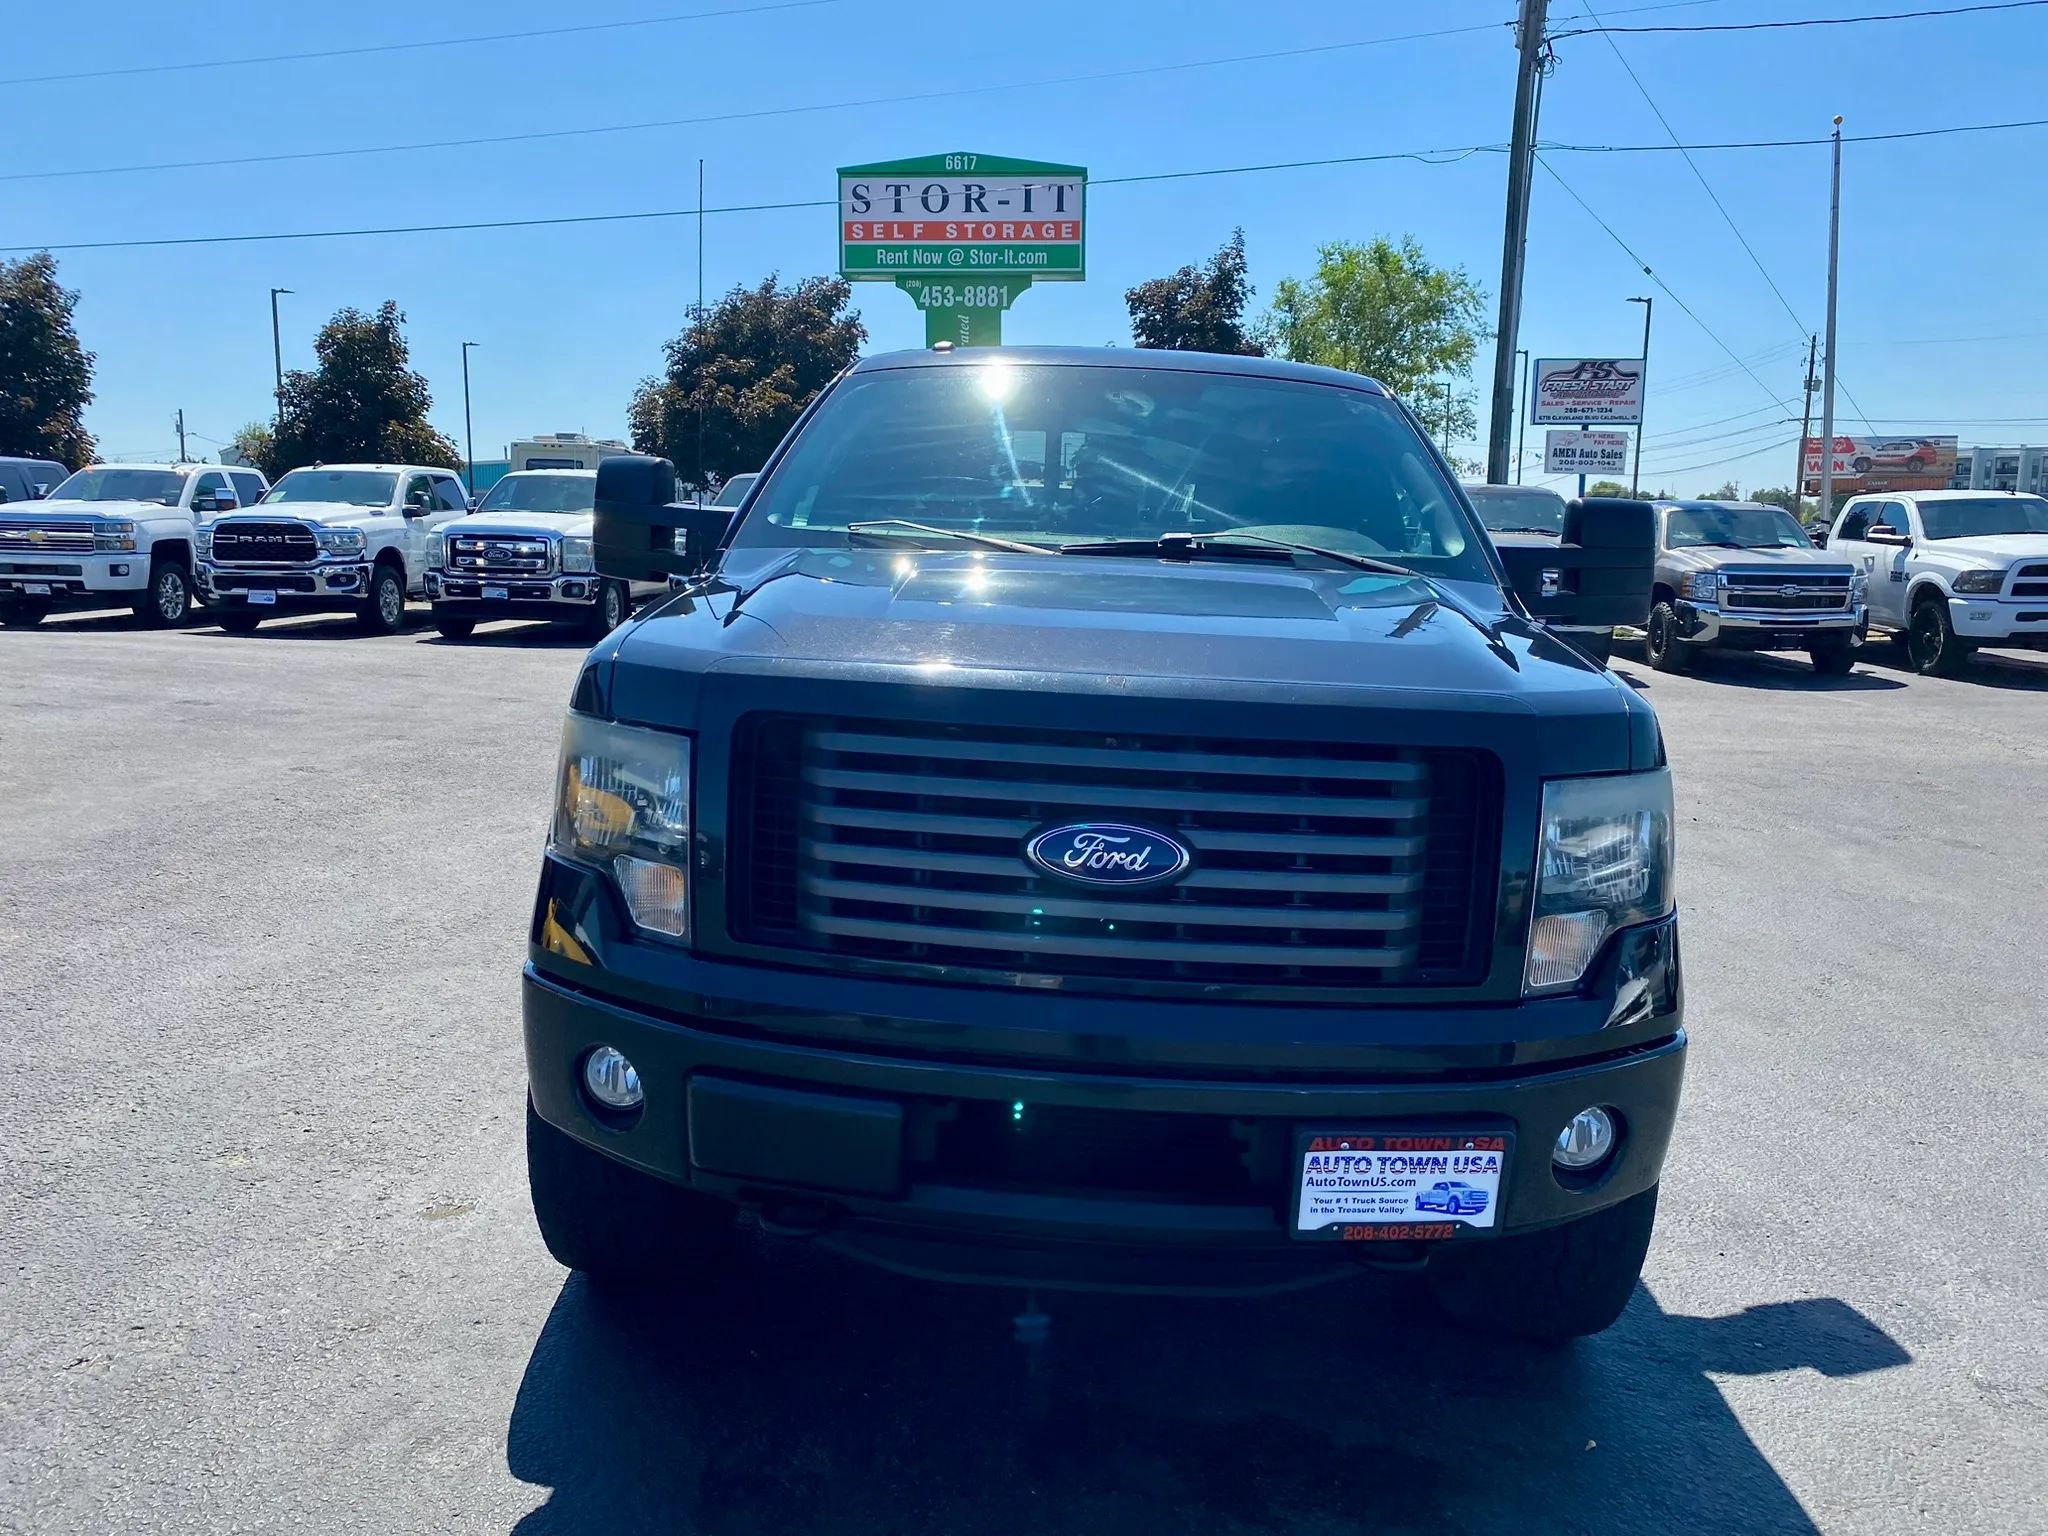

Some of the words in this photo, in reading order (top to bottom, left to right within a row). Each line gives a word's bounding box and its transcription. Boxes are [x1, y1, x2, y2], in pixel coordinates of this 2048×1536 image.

[945, 155, 977, 170] 6617
[851, 183, 1073, 214] STOR-IT
[852, 223, 924, 239] SELF
[945, 223, 1073, 239] STORAGE
[877, 249, 909, 265] Rent
[913, 249, 943, 265] Now
[947, 248, 965, 266] @
[969, 249, 1048, 265] Stor-It.com
[905, 280, 922, 289] (208)
[920, 285, 1008, 307] 453-8881
[957, 314, 970, 346] ated
[1542, 380, 1590, 392] FRESH
[1589, 379, 1637, 391] START
[1552, 447, 1577, 458] AMEN
[1579, 448, 1598, 459] Auto
[1601, 448, 1623, 459] Sales
[1807, 460, 1845, 472] WN
[239, 535, 283, 543] RAM
[1063, 833, 1152, 872] Ford
[1310, 1136, 1376, 1151] AUTO
[1383, 1136, 1449, 1151] TOWN
[1305, 1156, 1372, 1175] AUTO
[1376, 1156, 1448, 1175] TOWN
[1453, 1156, 1498, 1175] USA
[1306, 1177, 1416, 1188] AutoTownUS.com
[1351, 1197, 1376, 1205] Truck
[1378, 1197, 1409, 1205] Source
[1310, 1206, 1319, 1214] in
[1321, 1206, 1335, 1214] the
[1338, 1206, 1376, 1214] Treasure
[1343, 1225, 1454, 1241] 208-402-5772
